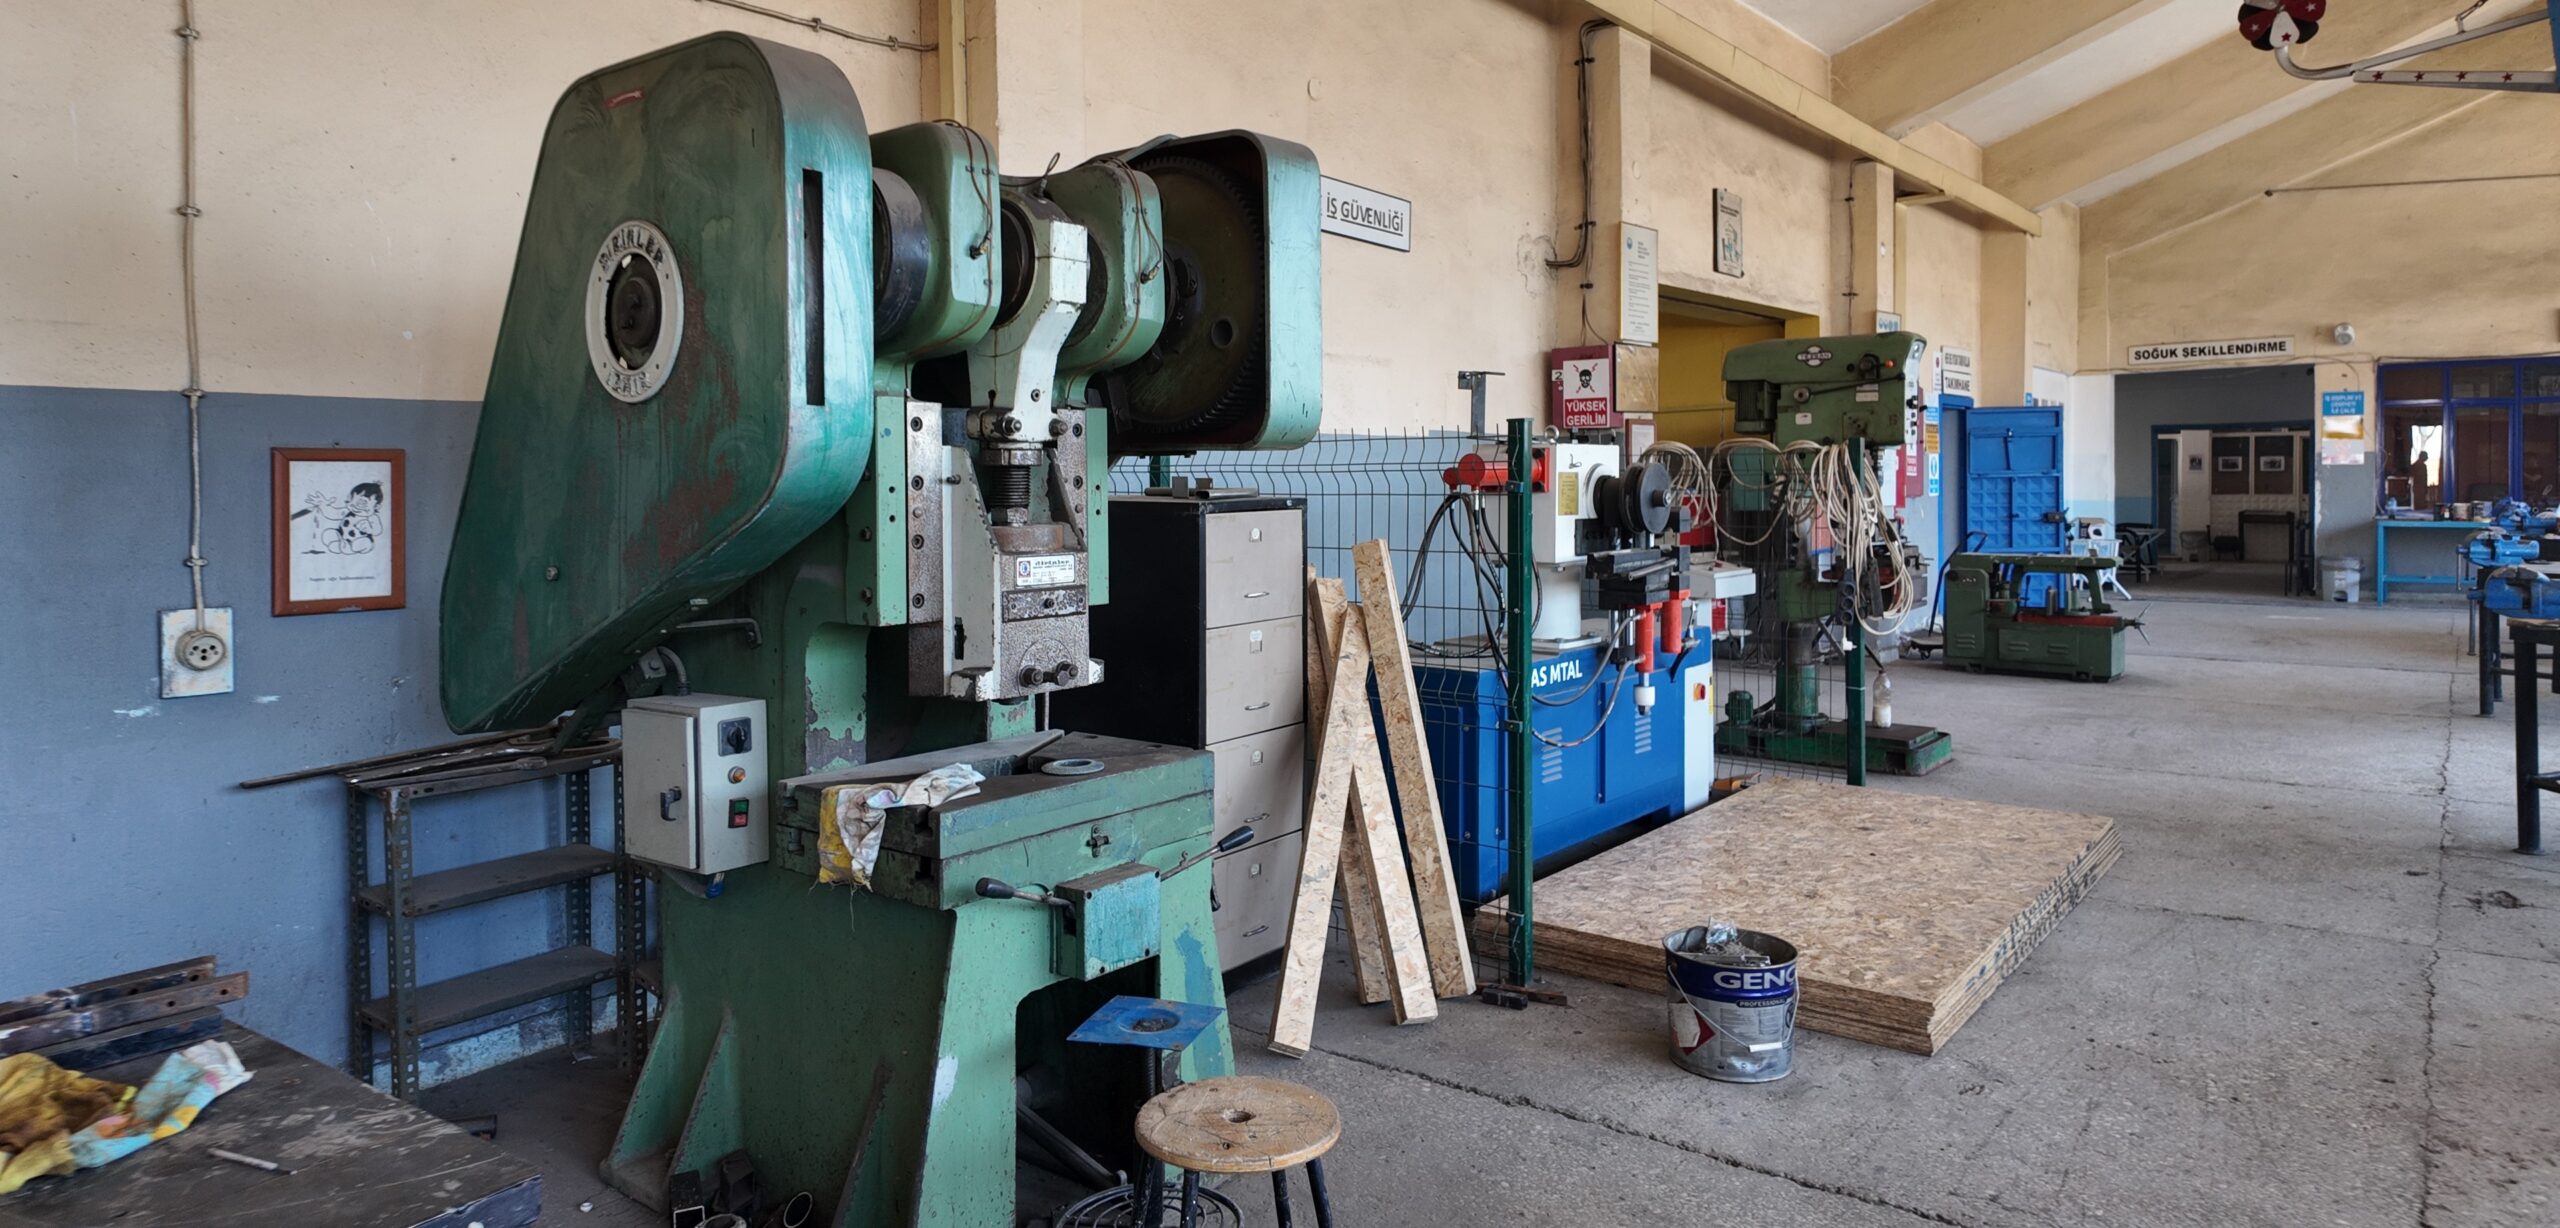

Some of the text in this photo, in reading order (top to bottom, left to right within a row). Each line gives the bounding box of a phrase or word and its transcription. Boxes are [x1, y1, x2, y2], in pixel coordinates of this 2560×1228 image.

[1326, 192, 1404, 233] İŞ GÜVENLİĞİ
[2134, 341, 2287, 360] SOĞUK ŞEKİLLENDİRME
[1566, 400, 1607, 412] YÜKSEK
[1566, 412, 1607, 426] GERİLİM
[1549, 659, 1583, 685] MTAL
